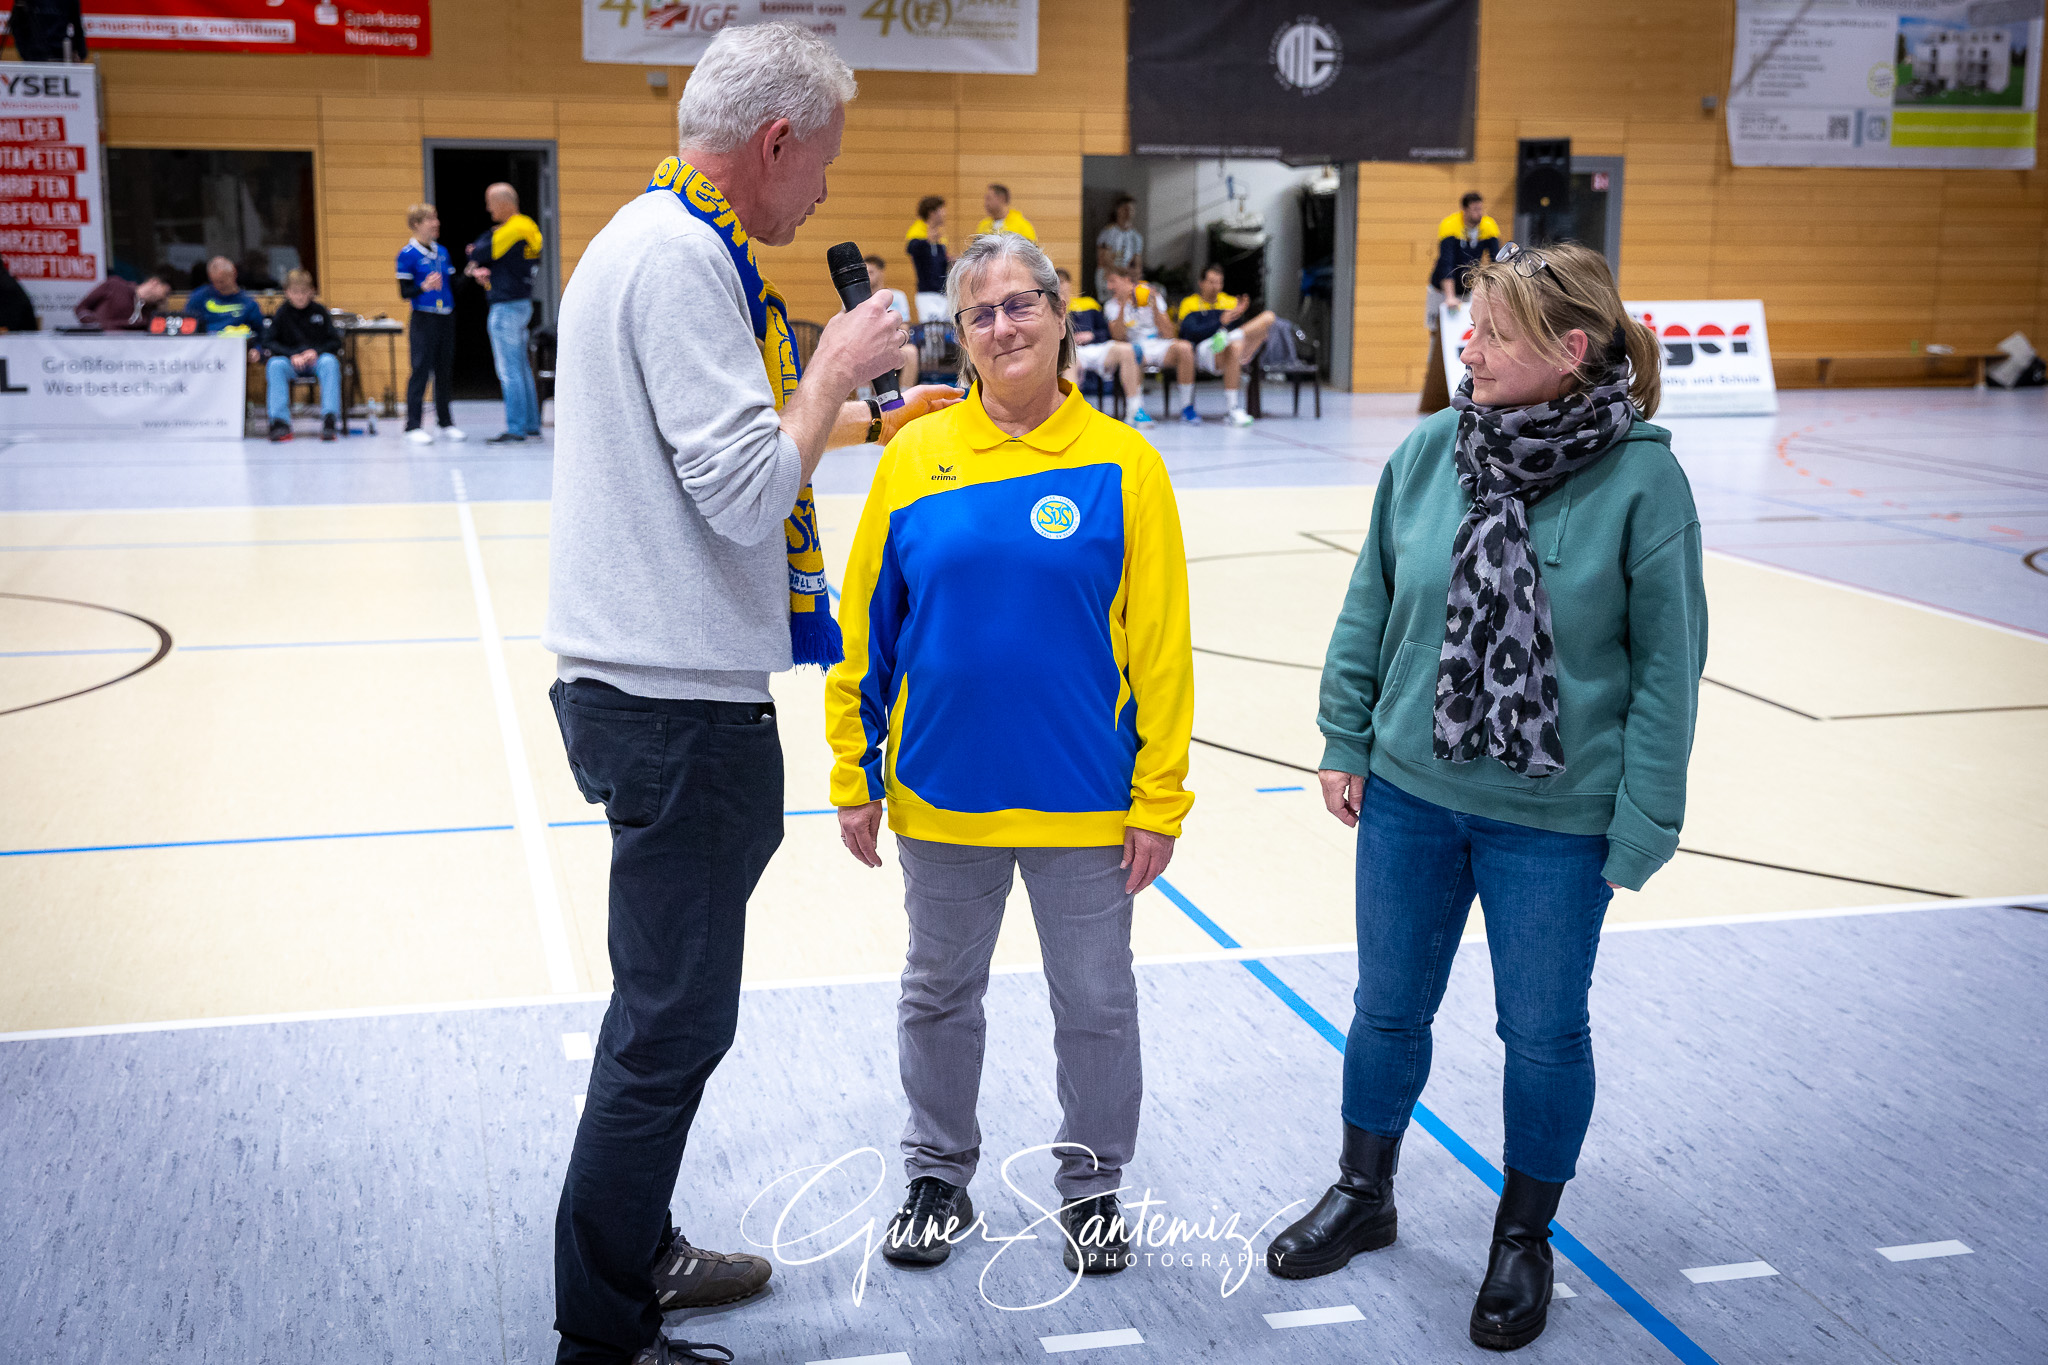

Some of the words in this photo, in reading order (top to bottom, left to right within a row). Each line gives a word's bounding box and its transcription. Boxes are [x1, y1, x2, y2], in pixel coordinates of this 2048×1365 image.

[344, 9, 420, 29] Sparkasse
[344, 28, 417, 50] Nürnberg
[42, 356, 226, 374] Großformatdruck
[44, 379, 188, 396] Werbetechnik
